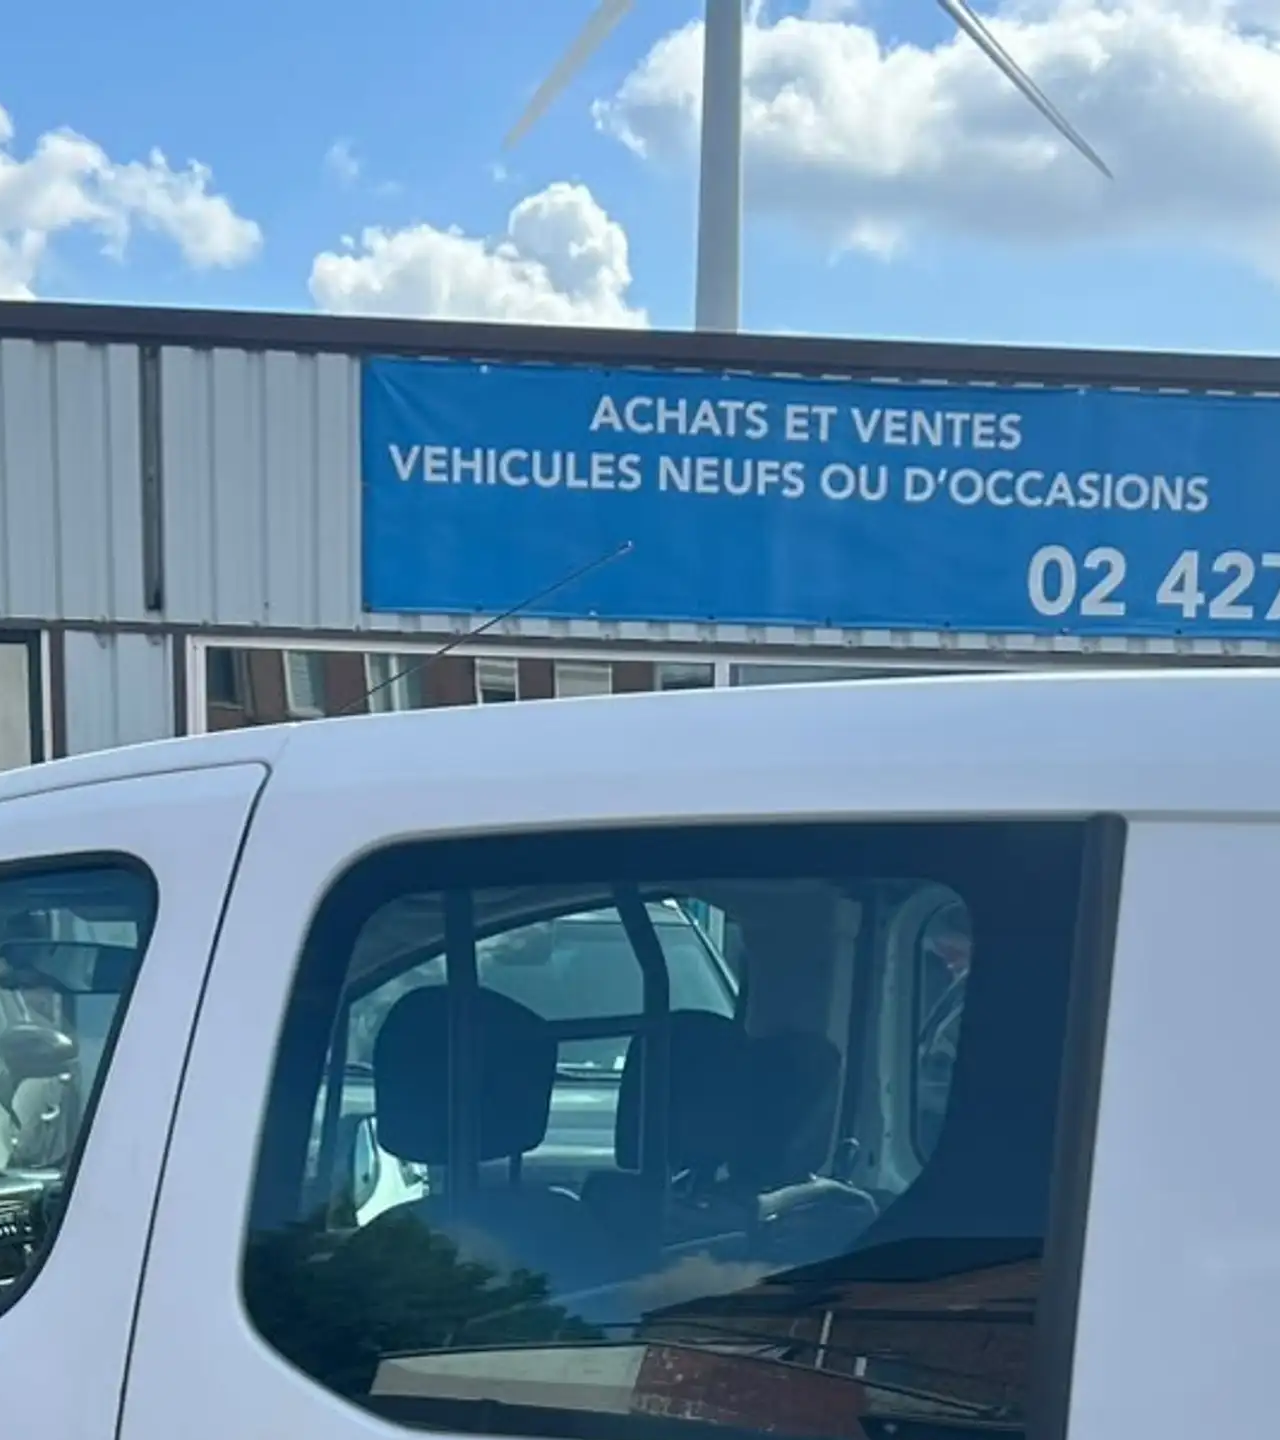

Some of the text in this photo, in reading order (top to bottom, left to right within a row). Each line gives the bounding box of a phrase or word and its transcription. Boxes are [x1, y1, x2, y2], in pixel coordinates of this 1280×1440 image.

[589, 396, 1022, 449] ACHATS ET VENTES
[388, 445, 1209, 512] VEHICULES NEUFS OU D'OCCASIONS
[1027, 545, 1127, 616] 02
